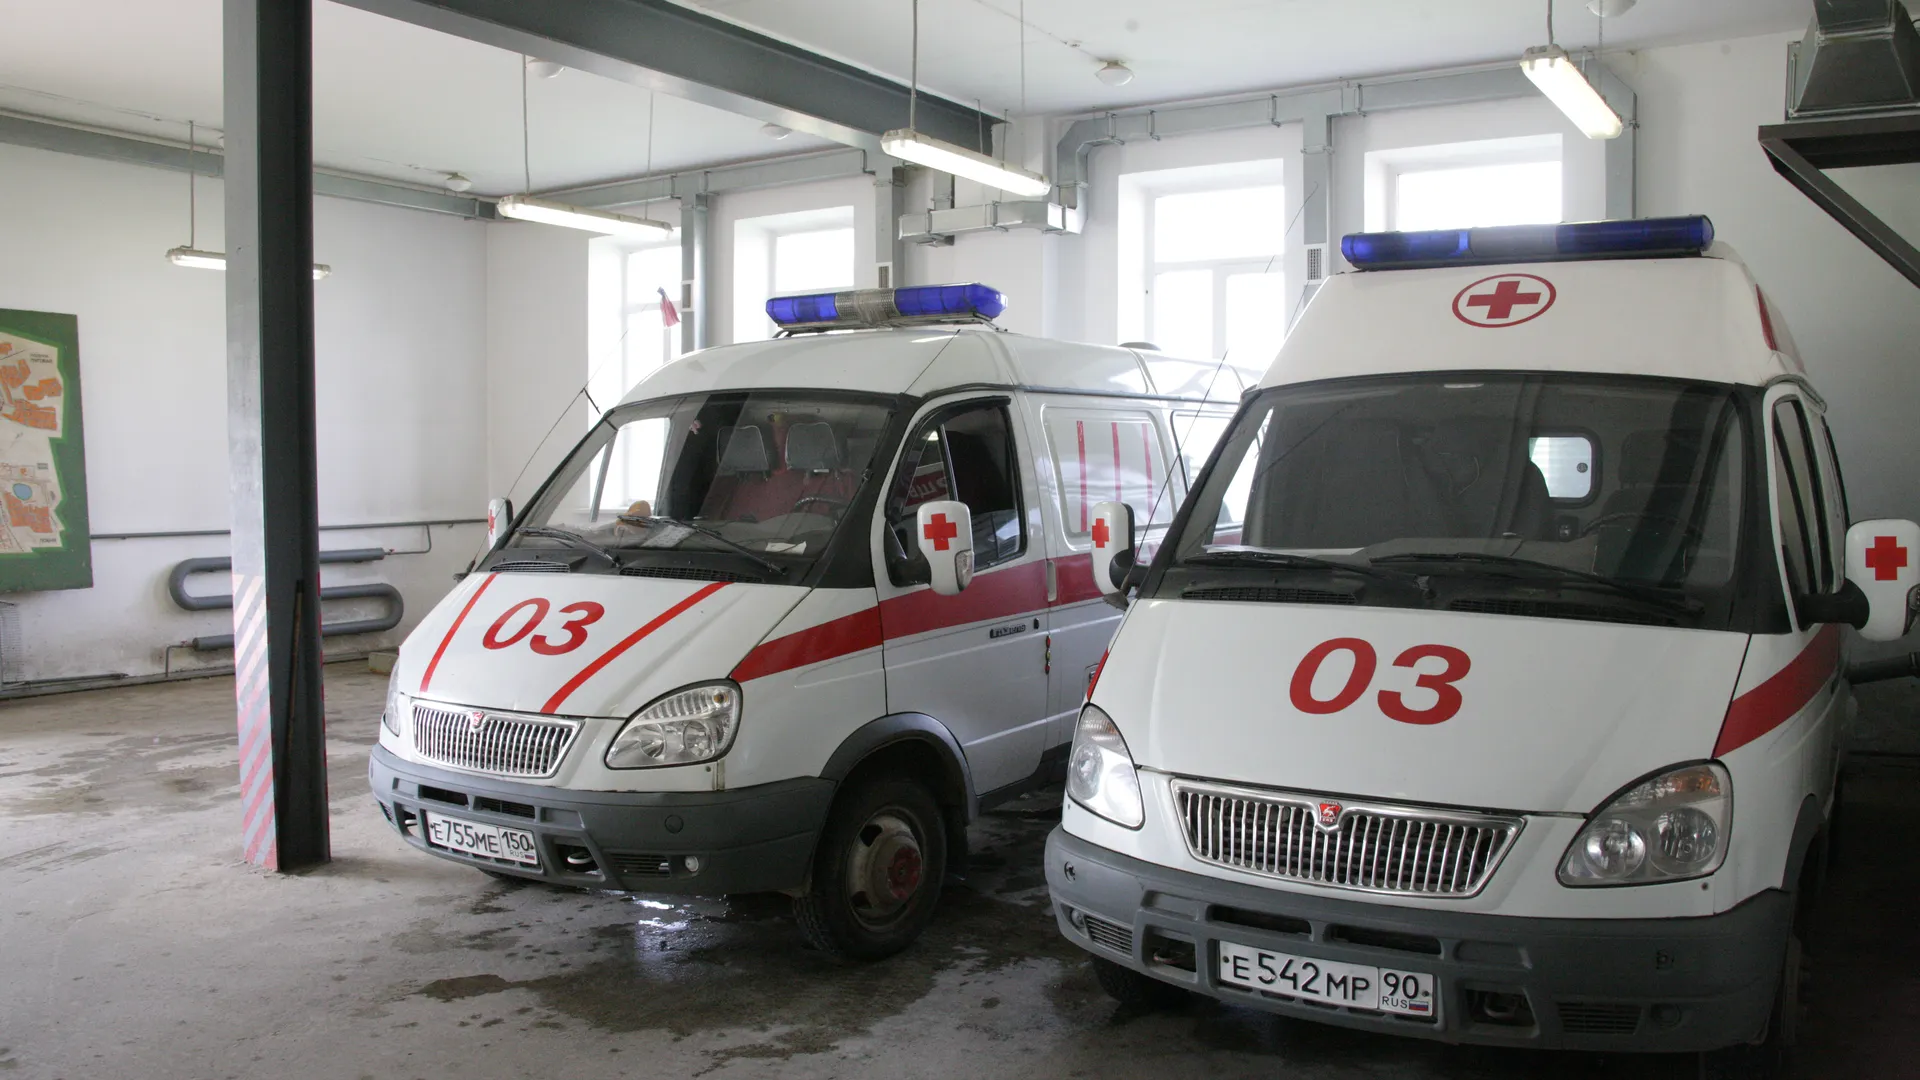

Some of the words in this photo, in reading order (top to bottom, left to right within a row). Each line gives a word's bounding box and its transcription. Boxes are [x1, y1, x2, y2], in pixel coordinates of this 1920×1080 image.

[482, 597, 605, 656] 03
[1289, 637, 1471, 725] 03
[502, 831, 530, 851] 150
[510, 849, 525, 859] RUS
[1384, 972, 1419, 999] 90
[1382, 995, 1408, 1009] RUS
